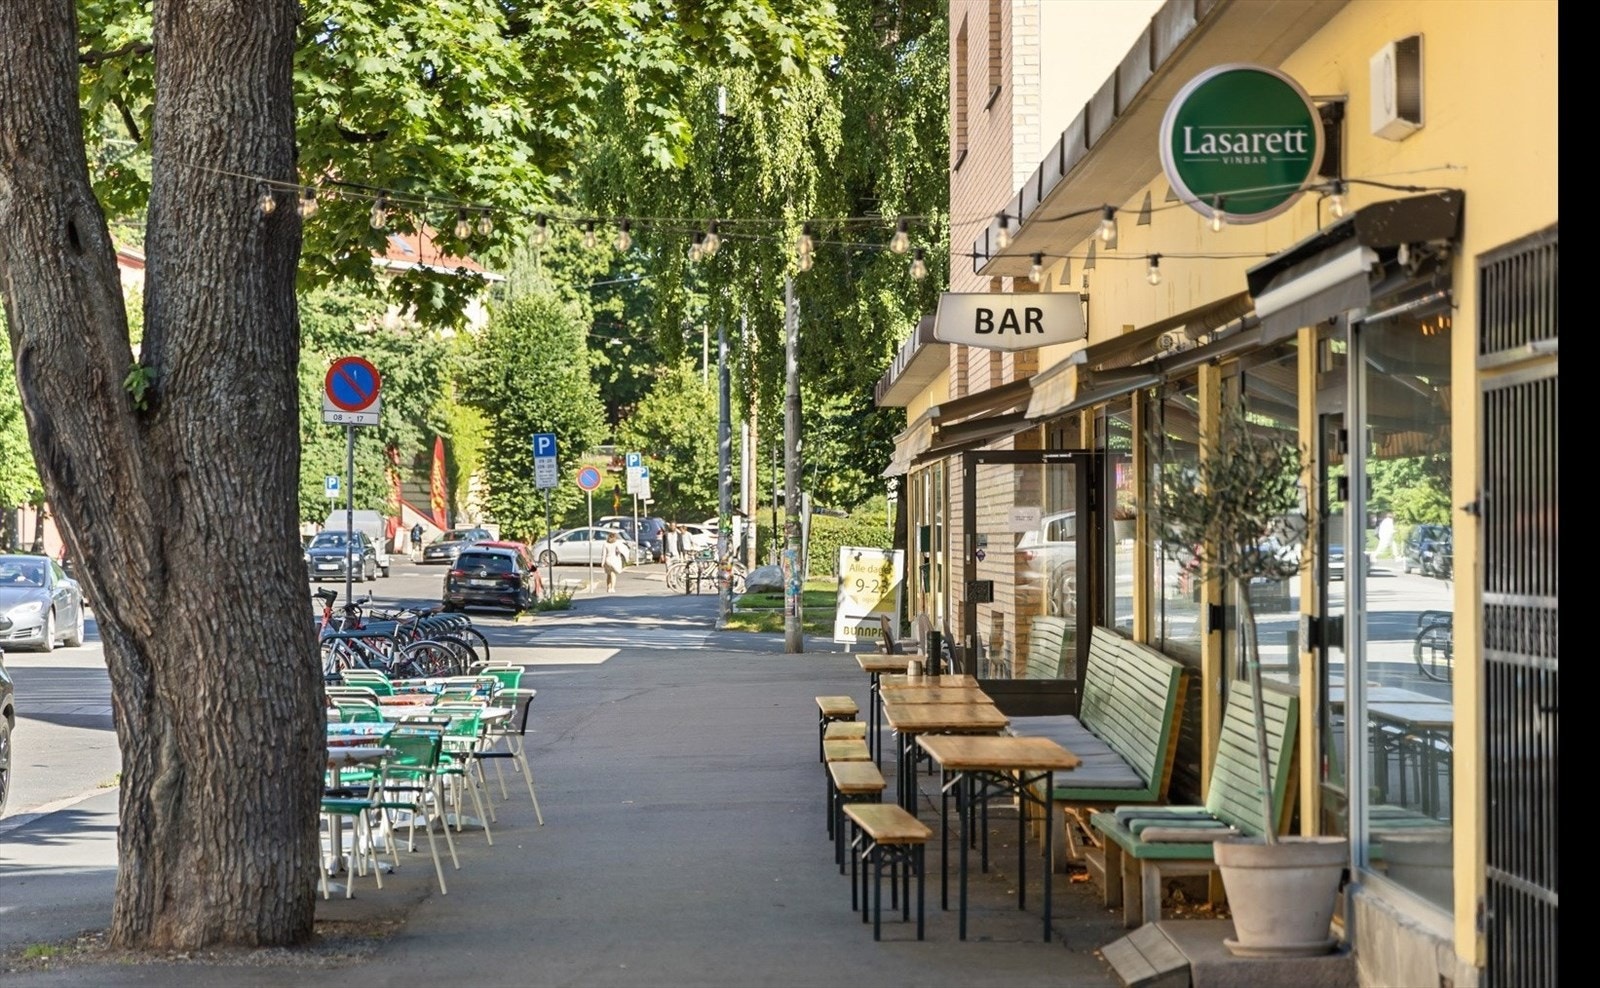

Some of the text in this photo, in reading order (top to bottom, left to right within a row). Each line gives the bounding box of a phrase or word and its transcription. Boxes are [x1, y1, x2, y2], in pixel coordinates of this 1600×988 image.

[1183, 126, 1308, 154] Lasarett
[1222, 156, 1268, 164] VINBAR
[975, 307, 1045, 334] BAR
[539, 437, 550, 455] P
[630, 455, 638, 466] P
[329, 478, 336, 488] P
[848, 563, 866, 573] Alle
[855, 578, 888, 593] 9-23
[843, 626, 884, 637] BUNNPR
